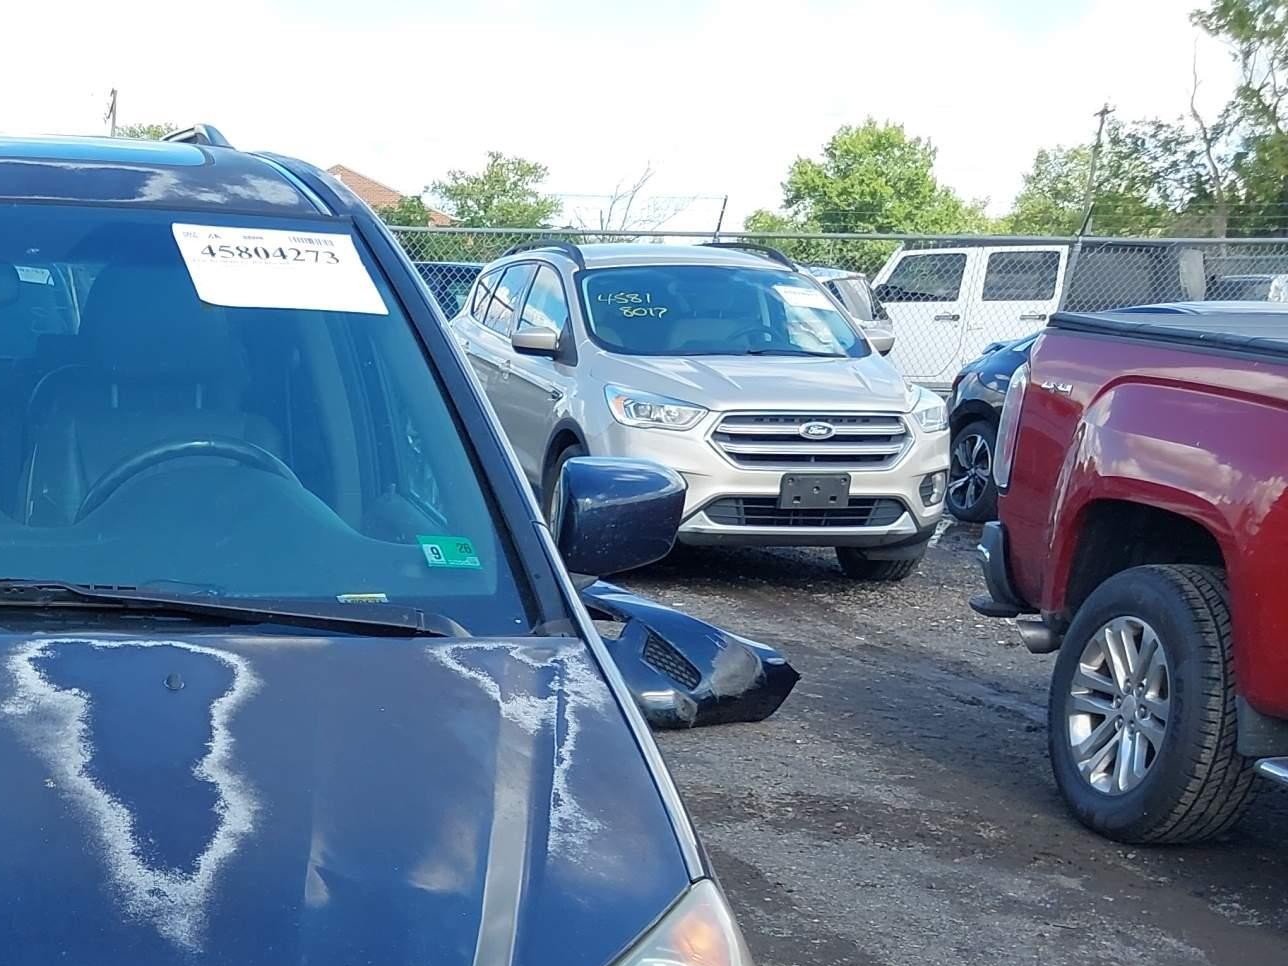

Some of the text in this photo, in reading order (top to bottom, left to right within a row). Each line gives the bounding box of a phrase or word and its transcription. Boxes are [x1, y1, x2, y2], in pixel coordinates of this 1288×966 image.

[200, 243, 341, 265] 45804273
[597, 292, 651, 305] 4581
[618, 306, 668, 319] 8017
[430, 546, 441, 560] 9
